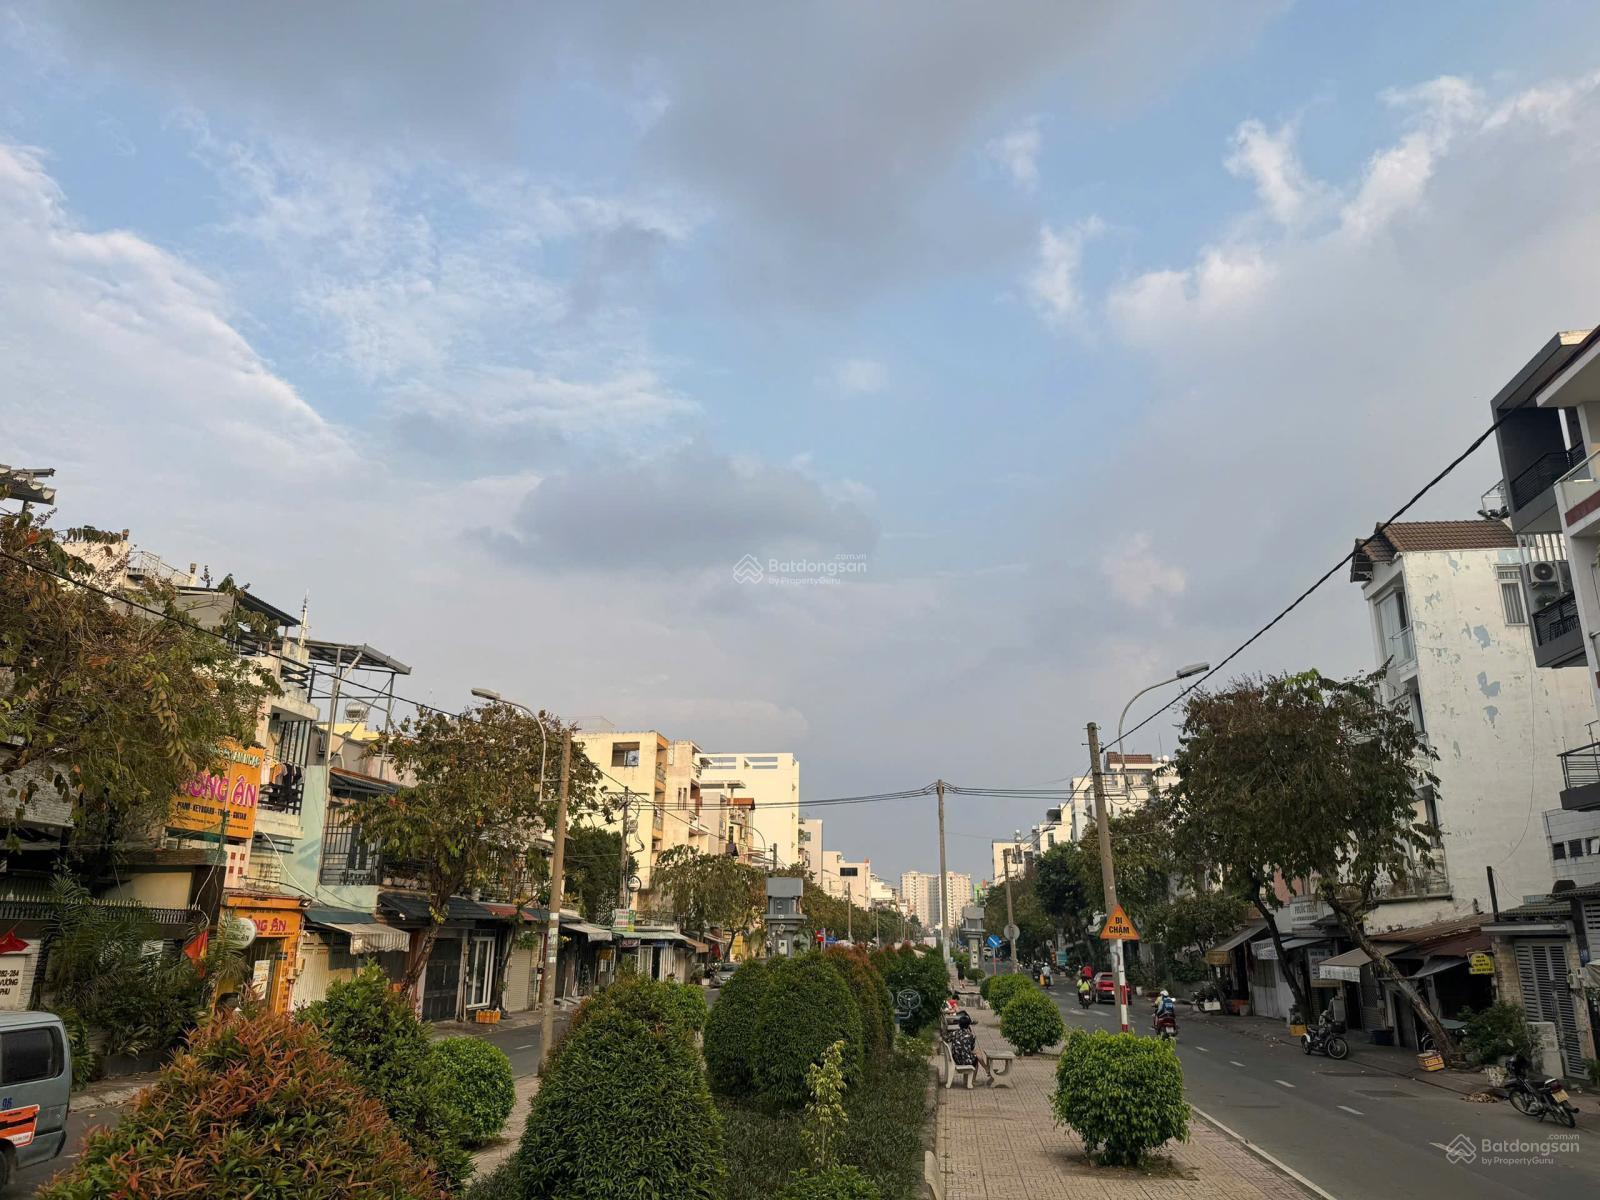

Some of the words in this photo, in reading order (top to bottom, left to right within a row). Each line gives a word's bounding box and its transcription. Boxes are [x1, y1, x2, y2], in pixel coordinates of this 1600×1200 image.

[231, 775, 257, 808] ÂN
[270, 917, 286, 931] ÂN
[1108, 925, 1130, 935] CHẬM
